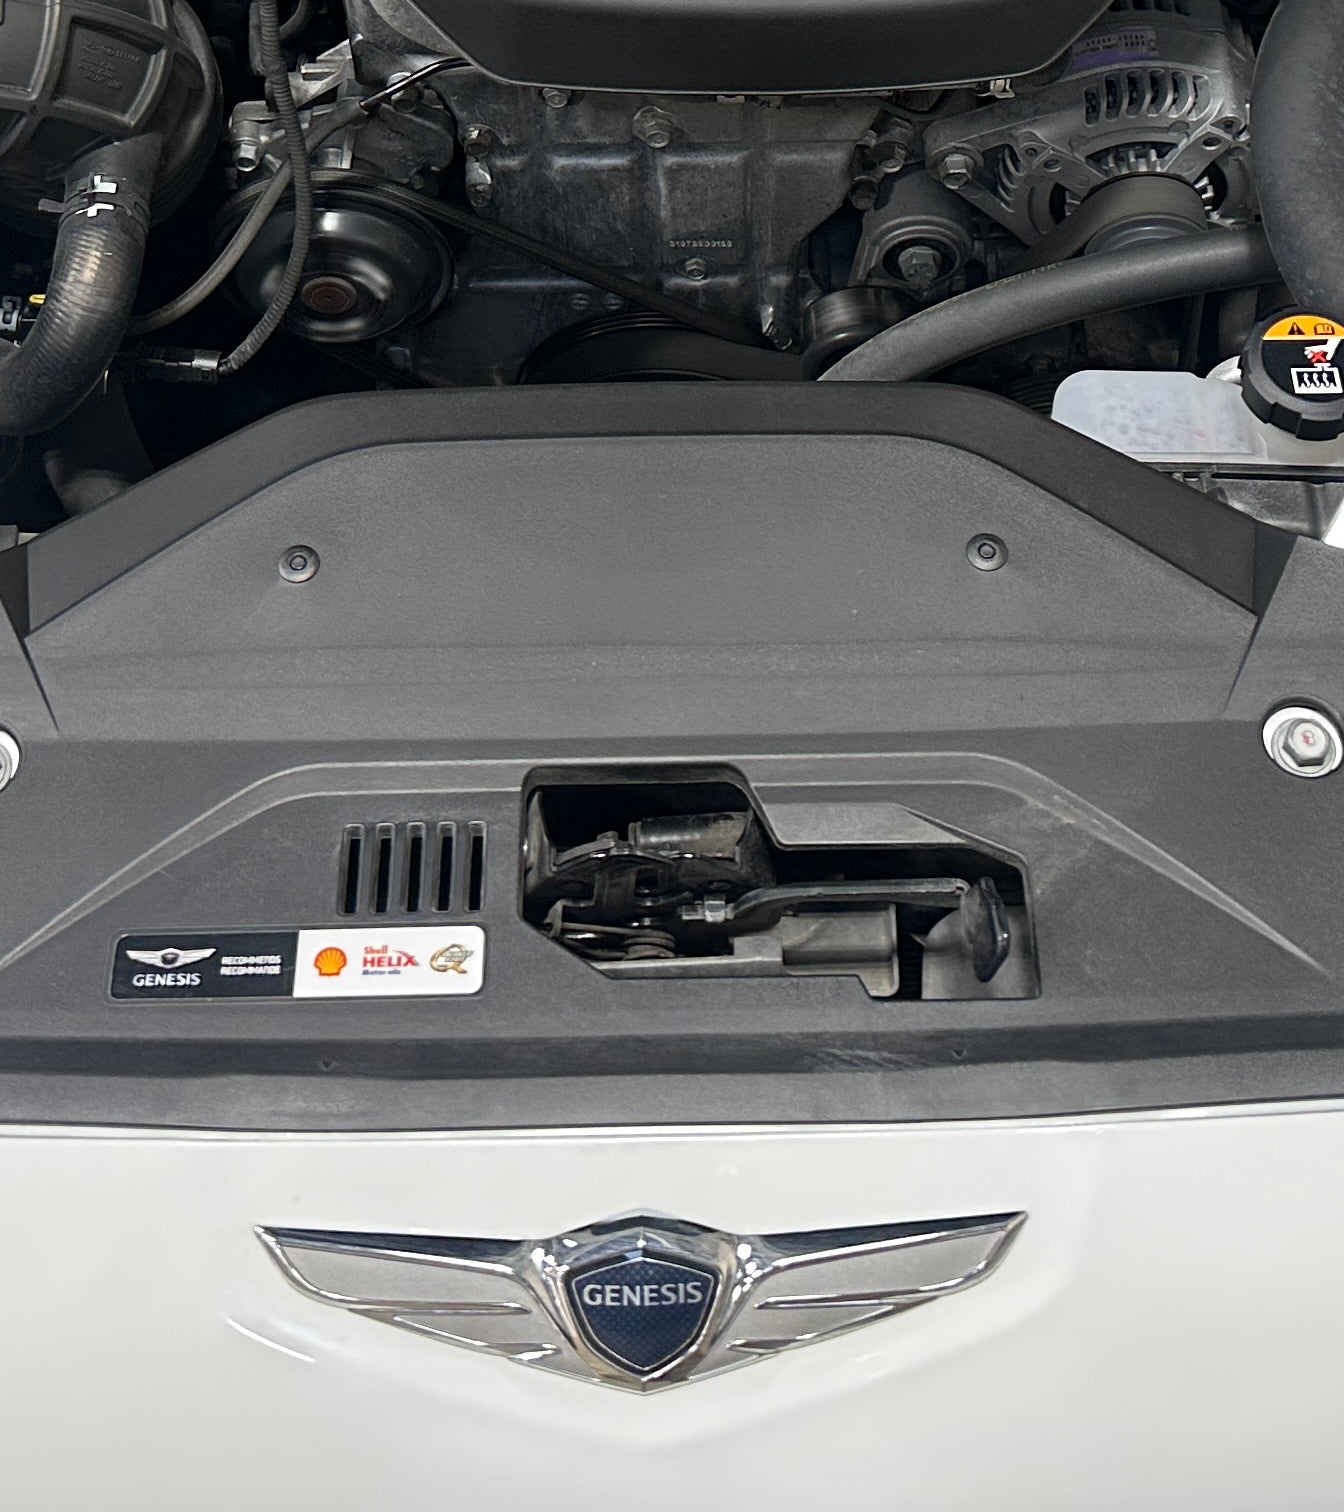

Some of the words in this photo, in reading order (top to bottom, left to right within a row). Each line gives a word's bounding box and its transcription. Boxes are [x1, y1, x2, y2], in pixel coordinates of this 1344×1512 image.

[363, 944, 388, 955] Shell
[362, 955, 418, 968] HELIX
[132, 972, 201, 988] GENESIS
[582, 1281, 703, 1308] GENESIS
